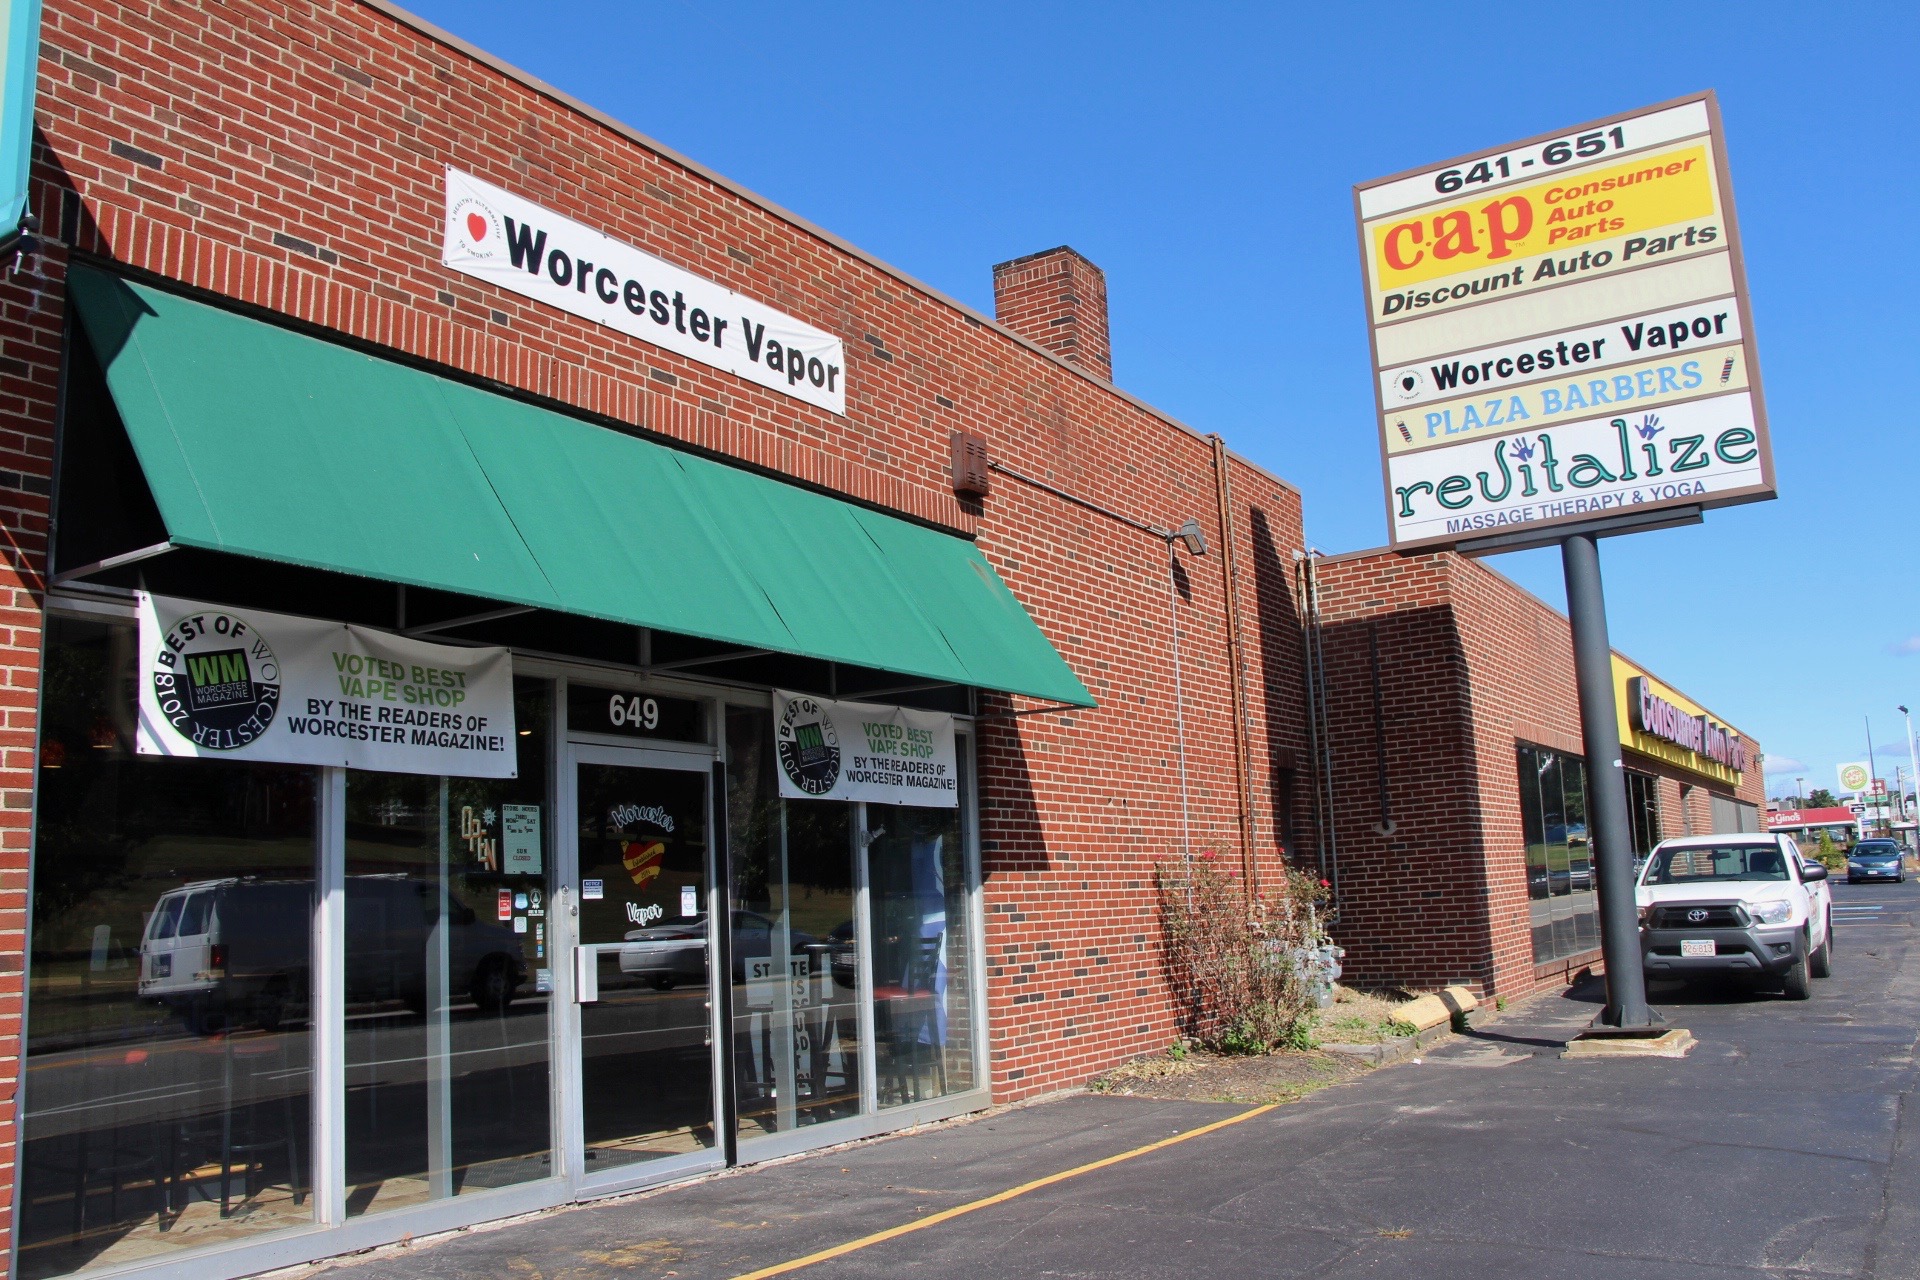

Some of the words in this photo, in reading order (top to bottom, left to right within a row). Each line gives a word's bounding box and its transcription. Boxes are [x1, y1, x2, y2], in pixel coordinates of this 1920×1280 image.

[1544, 156, 1697, 205] Consumer
[453, 197, 474, 216] HEALTHY
[475, 198, 501, 240] ALTERNATIVE
[1546, 198, 1614, 225] Auto
[1548, 215, 1626, 245] Parts
[467, 248, 494, 259] SMOKING
[1381, 265, 1524, 317] Discount
[1532, 248, 1613, 283] Auto
[1622, 225, 1718, 262] Parts
[504, 215, 728, 349] Worcester
[741, 316, 840, 392] Vapor
[1431, 335, 1607, 392] Worcester
[1622, 312, 1728, 352] Vapor
[1424, 395, 1530, 439] PLAZA
[1540, 360, 1703, 416] BARBERS
[1446, 507, 1534, 534] MASSAGE
[1538, 491, 1625, 519] THERAPY
[1631, 489, 1645, 506] &
[1649, 480, 1706, 502] YOGA
[158, 616, 205, 669] BEST
[214, 615, 247, 639] OF
[188, 653, 248, 687] WM
[332, 651, 405, 681] VOTED
[411, 665, 466, 689] BEST
[155, 673, 190, 728] 2018
[192, 638, 279, 749] WORCESTER
[195, 682, 248, 695] WORCESTER
[197, 689, 249, 704] MAGAZINE
[338, 675, 398, 701] VAPE
[403, 684, 466, 708] SHOP
[307, 698, 334, 716] BY
[338, 701, 372, 722] THE
[378, 706, 462, 730] READERS
[466, 715, 488, 732] OF
[609, 694, 659, 730] 649
[779, 701, 801, 738] BEST
[802, 699, 818, 716] OF
[1634, 676, 1703, 754] Consumer
[287, 717, 406, 744] WORCESTER
[411, 729, 505, 752] MAGAZINE!
[795, 726, 824, 749] WM
[862, 722, 903, 740] VOTED
[907, 729, 934, 745] BEST
[868, 739, 897, 755] VAPE
[900, 742, 934, 759] SHOP
[780, 743, 800, 780] 2019
[854, 756, 868, 769] BY
[870, 758, 890, 771] THE
[891, 760, 935, 775] READERS
[936, 764, 946, 776] OF
[846, 770, 903, 786] WORCESTER
[906, 774, 956, 791] MAGAZINE!
[611, 805, 675, 833] Worcester
[1775, 812, 1801, 824] Gino's
[626, 901, 663, 927] Vapor
